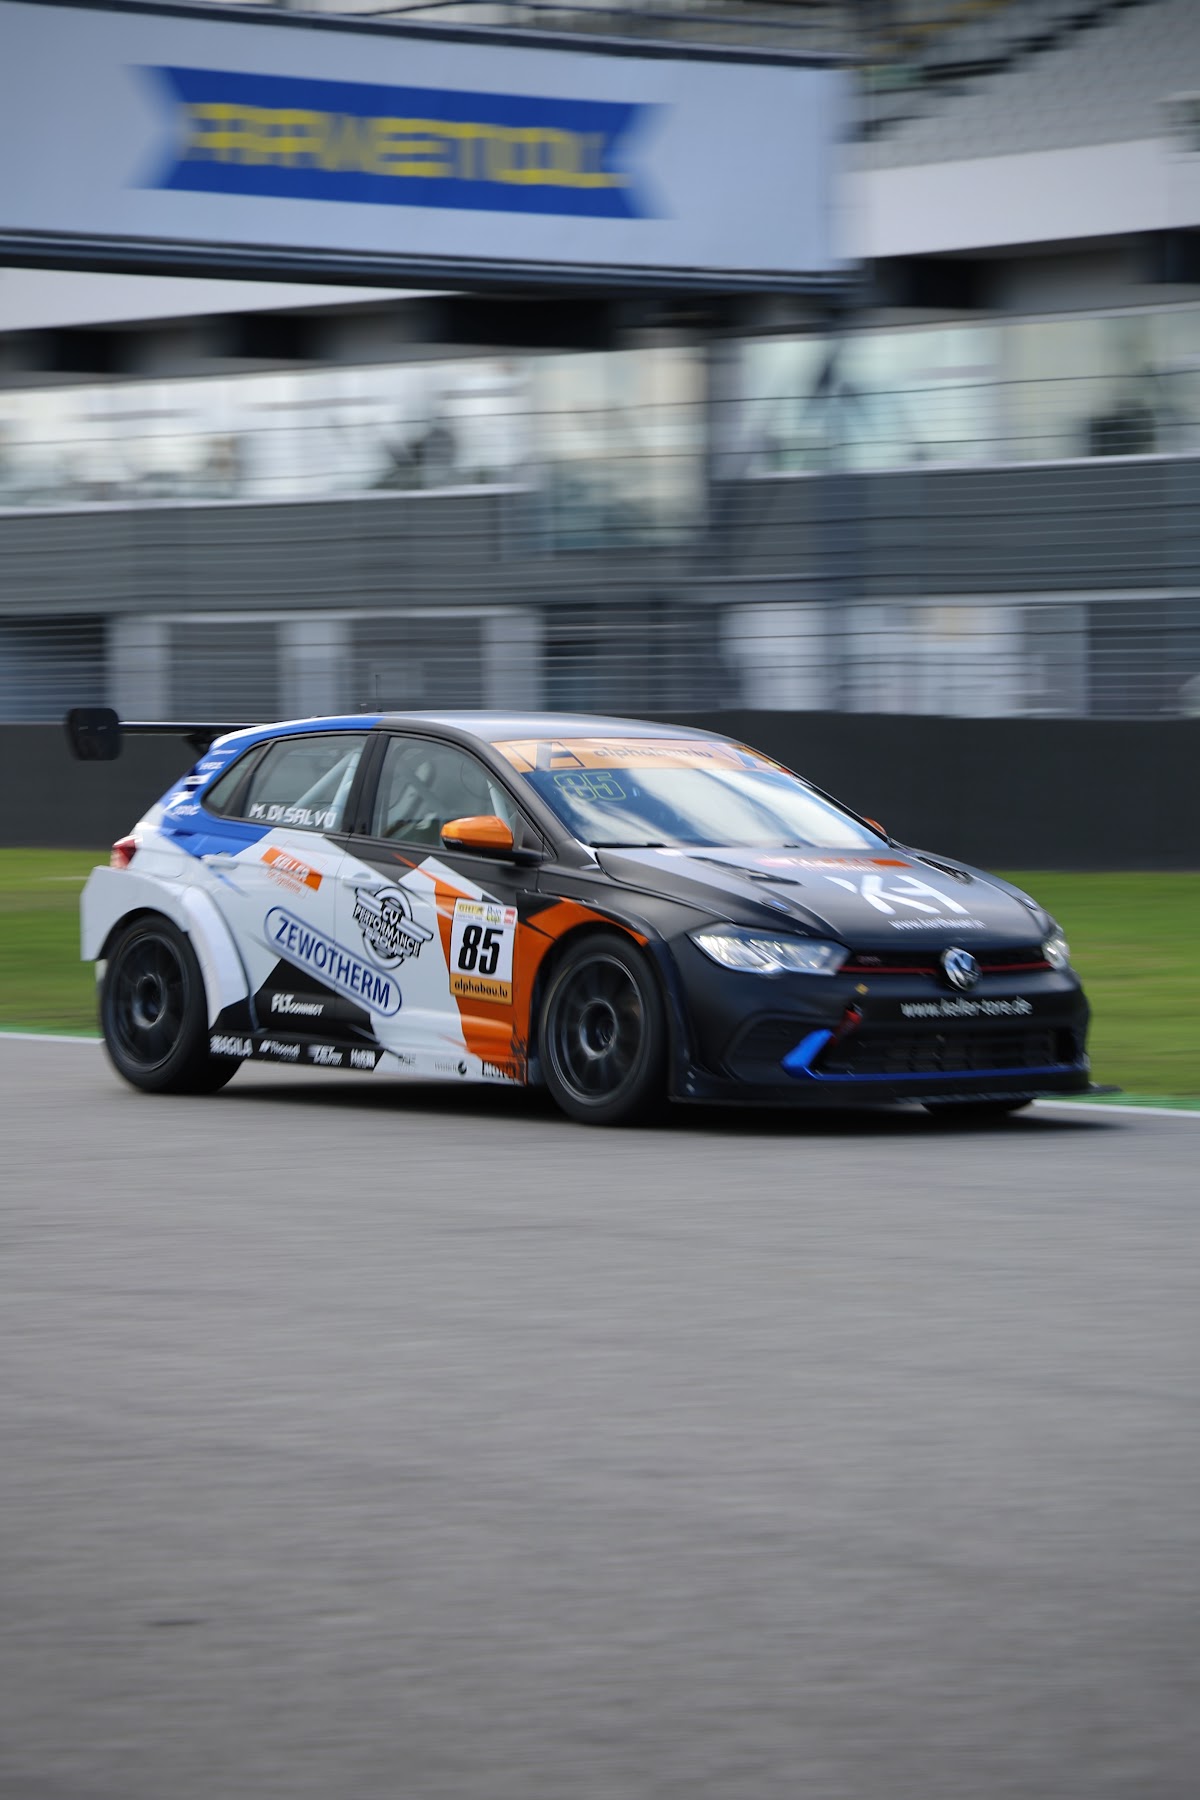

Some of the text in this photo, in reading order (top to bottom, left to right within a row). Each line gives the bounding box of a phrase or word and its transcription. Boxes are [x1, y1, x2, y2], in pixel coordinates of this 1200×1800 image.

[554, 772, 626, 800] 85
[283, 807, 337, 828] SALVO
[354, 905, 420, 957] PERFORMANCE
[458, 925, 504, 975] 85
[275, 916, 391, 1008] ZEWOTHERM
[455, 978, 508, 998] alphabau.lu
